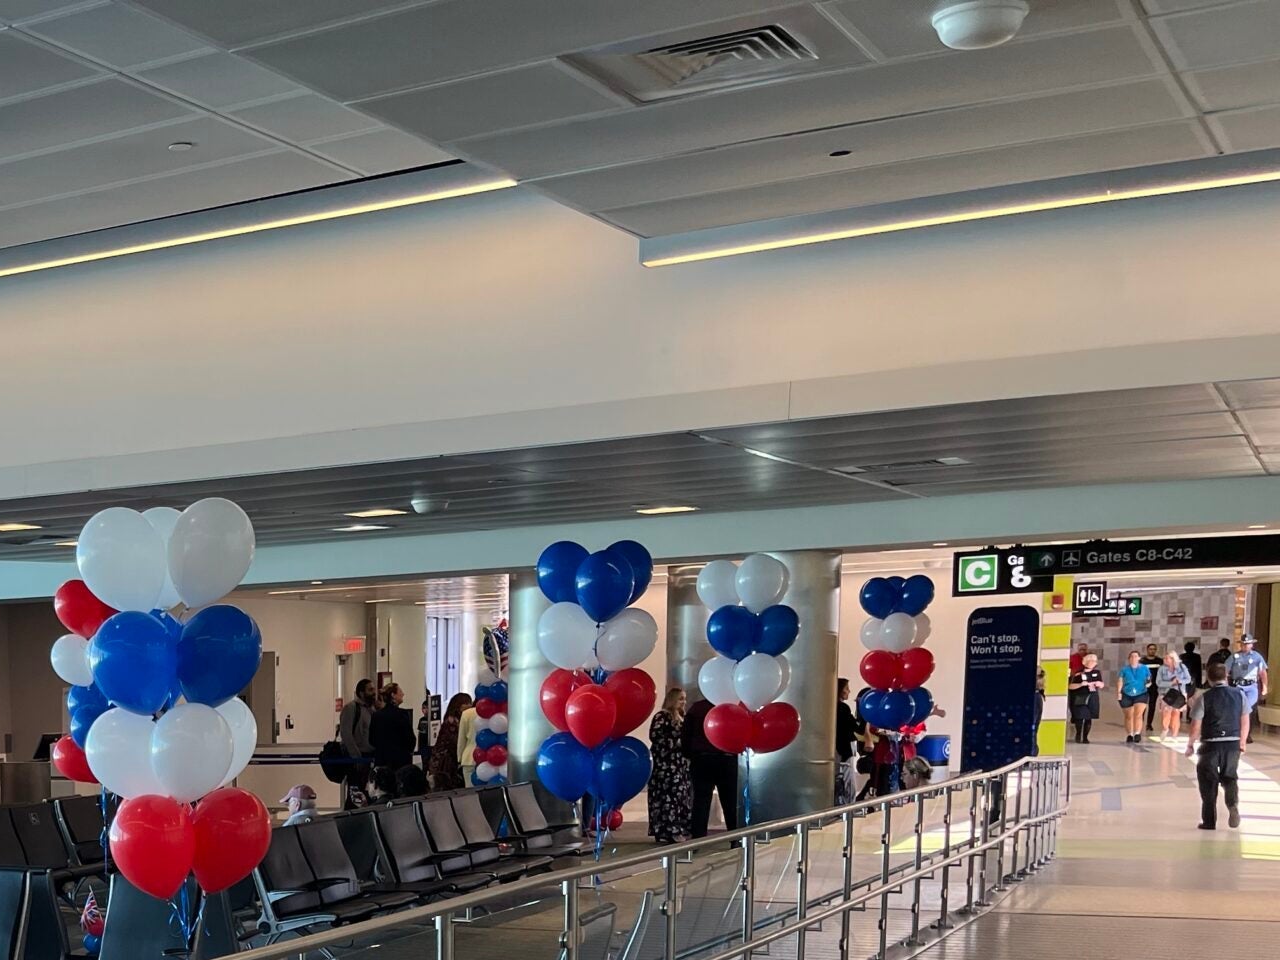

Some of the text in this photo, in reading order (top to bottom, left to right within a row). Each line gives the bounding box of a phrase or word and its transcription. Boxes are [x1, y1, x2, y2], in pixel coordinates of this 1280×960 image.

[1086, 547, 1193, 564] Gates C8-C42
[964, 560, 992, 586] C
[970, 633, 1021, 644] Can't stop.
[970, 644, 1024, 655] Won't stop.
